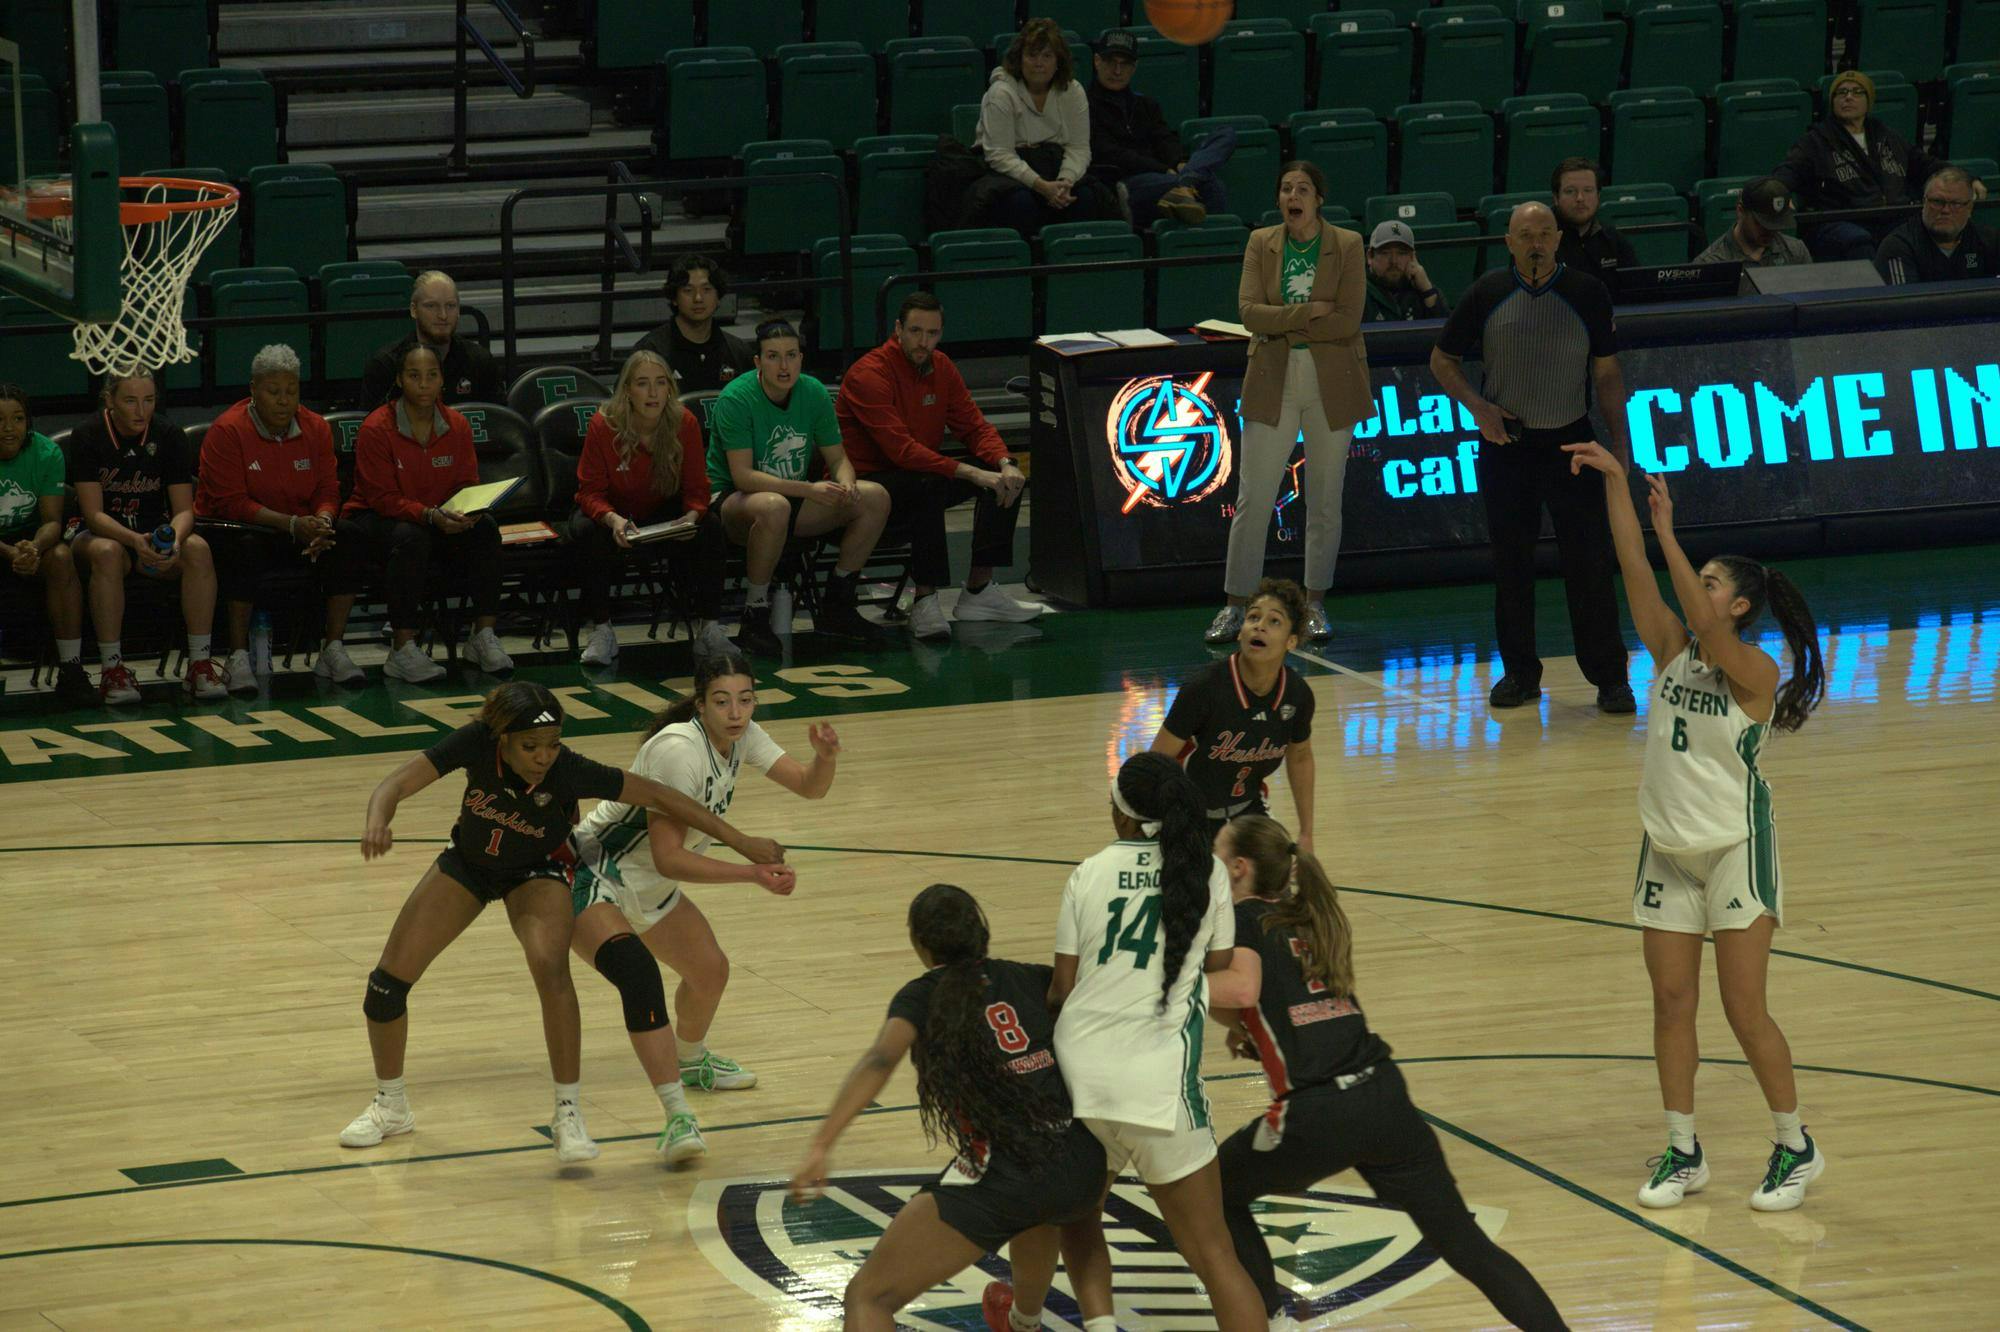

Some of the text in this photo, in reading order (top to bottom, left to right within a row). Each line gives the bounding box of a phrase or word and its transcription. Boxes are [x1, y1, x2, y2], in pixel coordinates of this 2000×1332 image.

[1626, 363, 2000, 474] COME IN
[1382, 440, 1480, 498] caf
[1660, 675, 1728, 717] ESTERN
[1671, 716, 1688, 752] 6
[1230, 765, 1253, 797] 2
[464, 788, 547, 839] Huskies
[484, 828, 505, 857] 1
[1136, 852, 1151, 866] E
[1643, 880, 1665, 909] E
[1097, 894, 1164, 970] 14
[985, 1001, 1031, 1055] 8
